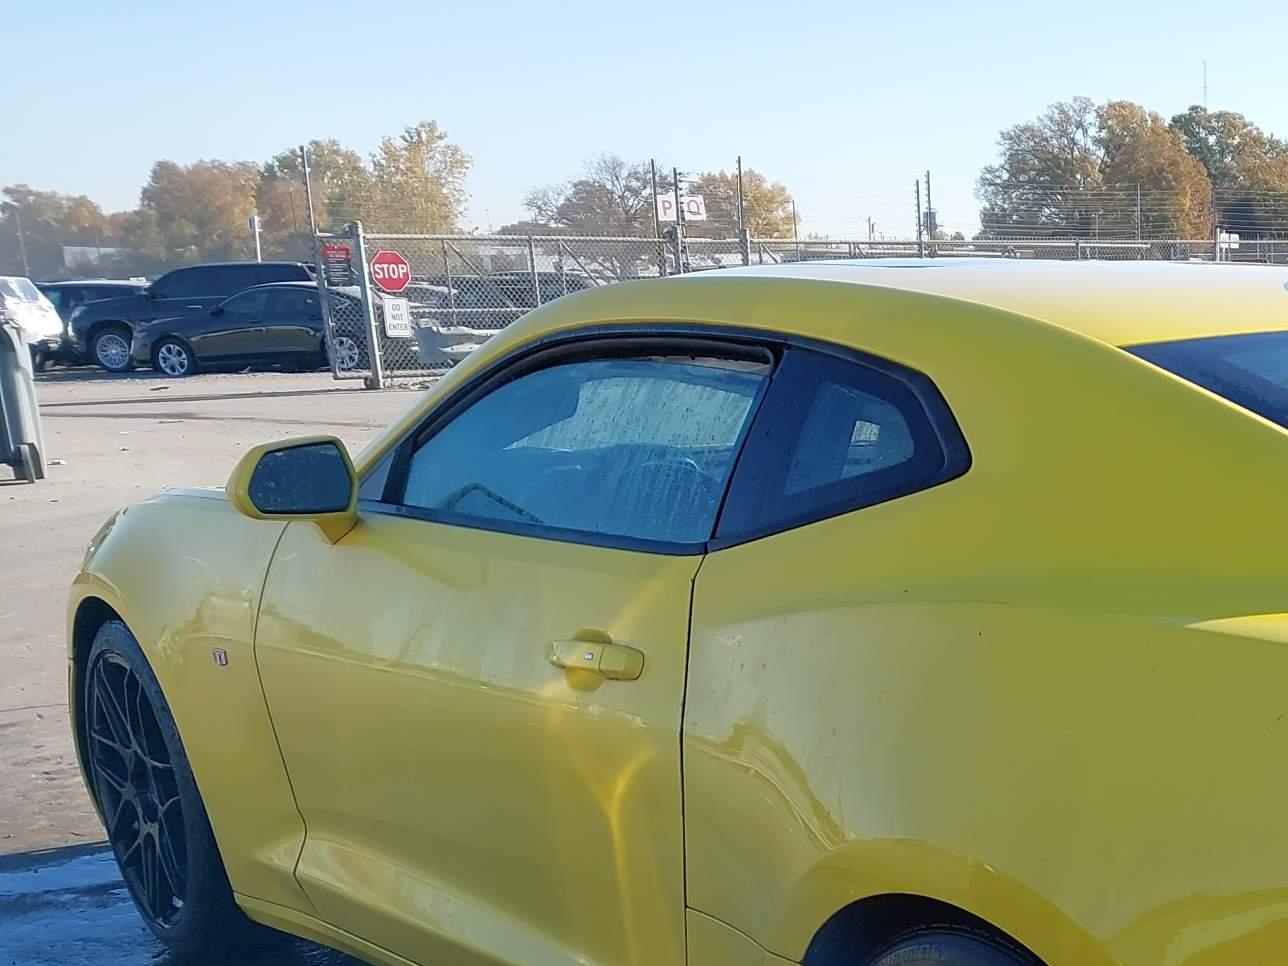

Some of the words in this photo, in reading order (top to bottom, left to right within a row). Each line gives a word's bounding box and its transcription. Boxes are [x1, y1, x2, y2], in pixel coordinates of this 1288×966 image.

[661, 199, 673, 217] P
[686, 199, 702, 216] Q
[374, 263, 407, 279] STOP
[391, 303, 401, 311] DO
[391, 313, 403, 321] NOT
[388, 323, 409, 331] ENTER
